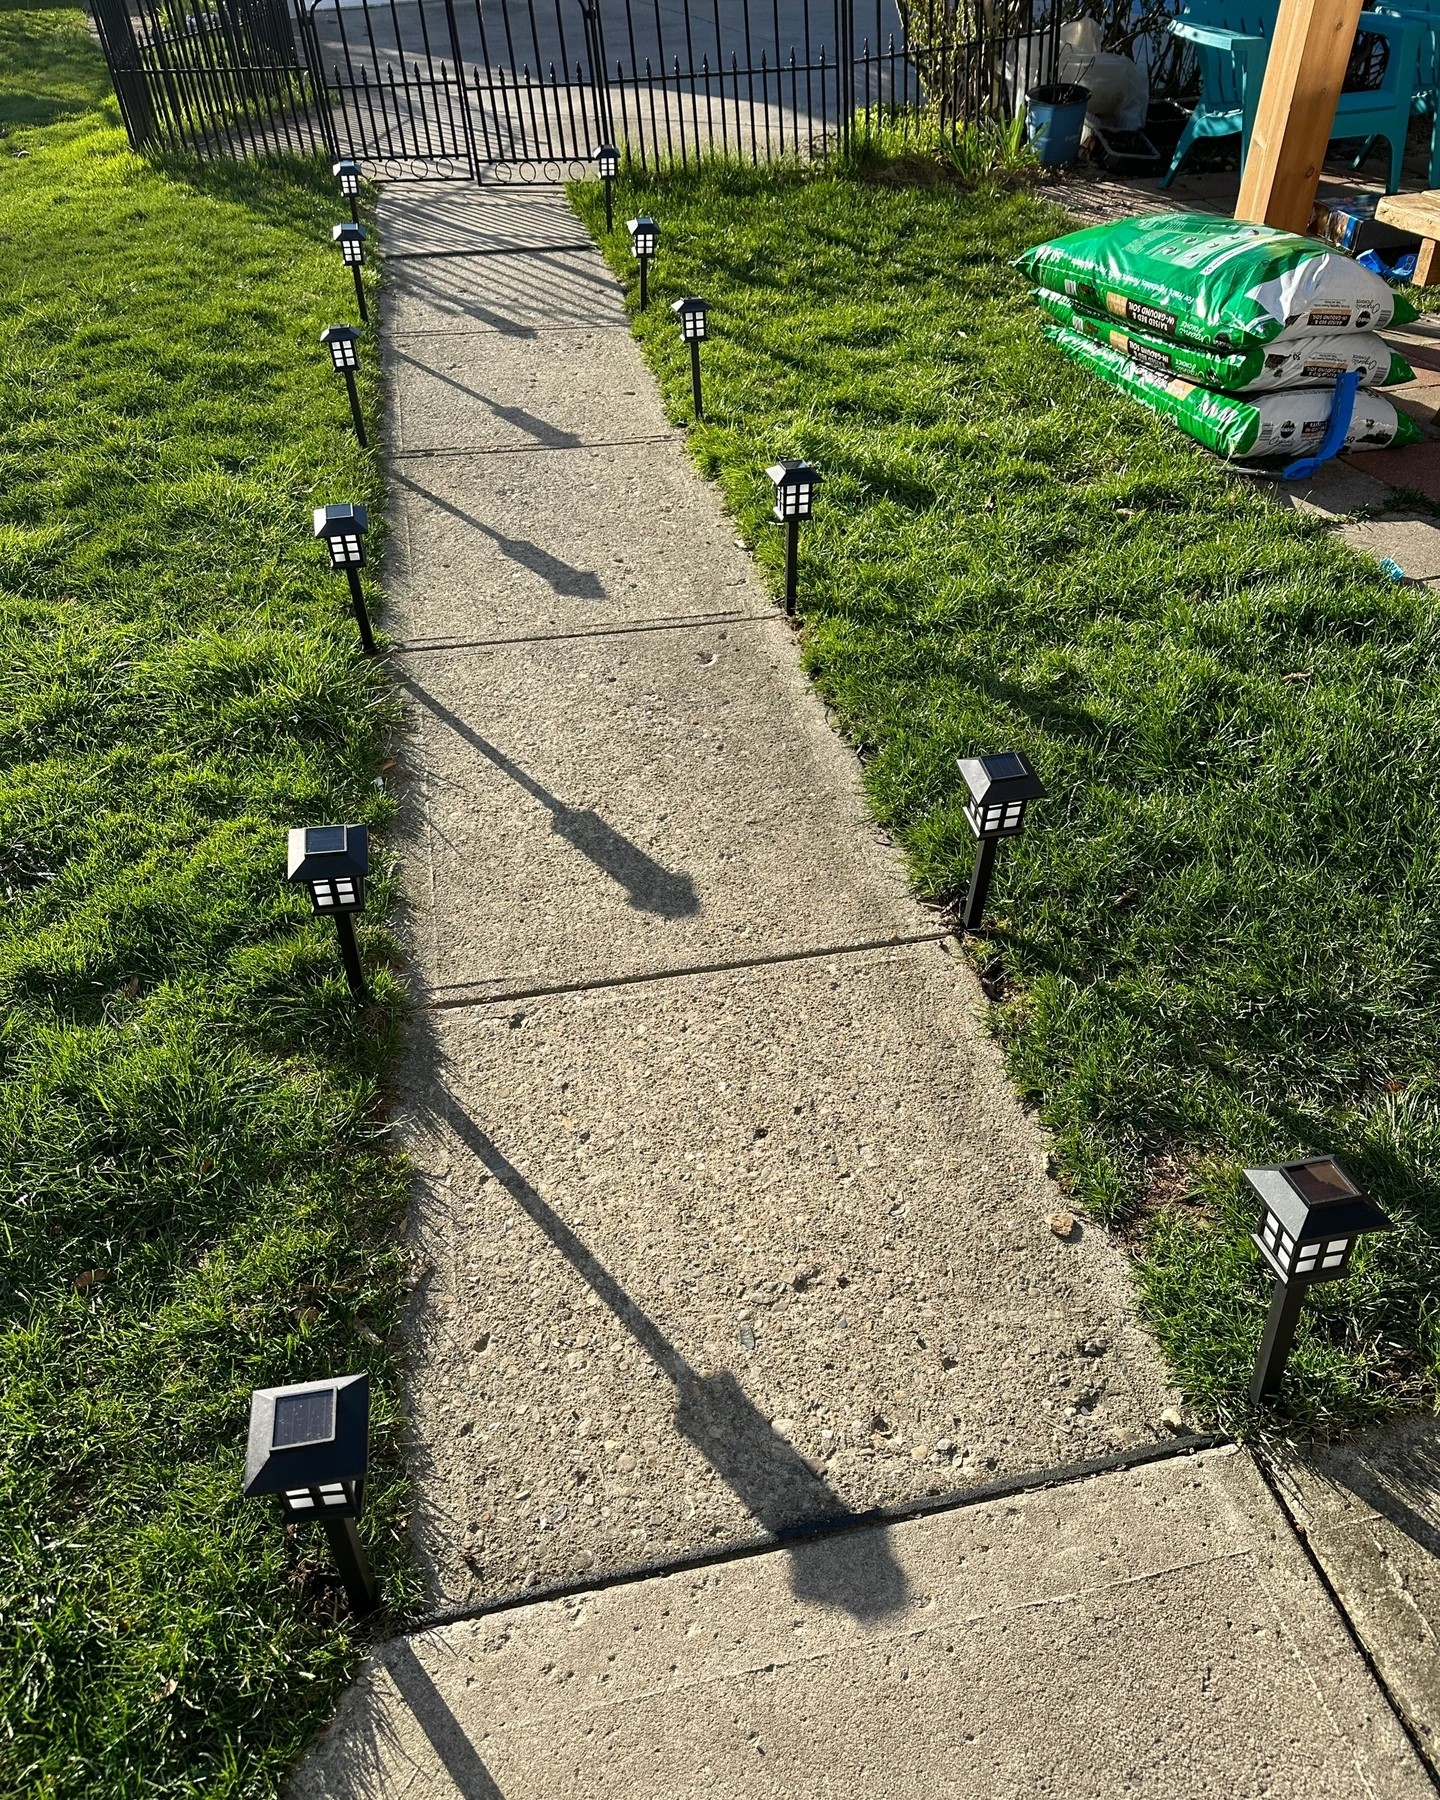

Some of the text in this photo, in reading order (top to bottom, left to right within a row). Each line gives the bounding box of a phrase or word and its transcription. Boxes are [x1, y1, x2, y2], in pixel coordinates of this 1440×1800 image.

[1185, 295, 1194, 304] For
[1128, 302, 1141, 313] SOIL
[1355, 303, 1380, 314] Organic
[1137, 314, 1148, 325] BED
[1141, 305, 1175, 325] IN-GROUND
[1148, 318, 1168, 331] RAISED
[1128, 340, 1140, 352] SOIL
[1141, 347, 1169, 363] IN-GROUND
[1175, 358, 1192, 370] CHOICE
[1351, 358, 1377, 370] Organic
[1174, 365, 1205, 380] Organic
